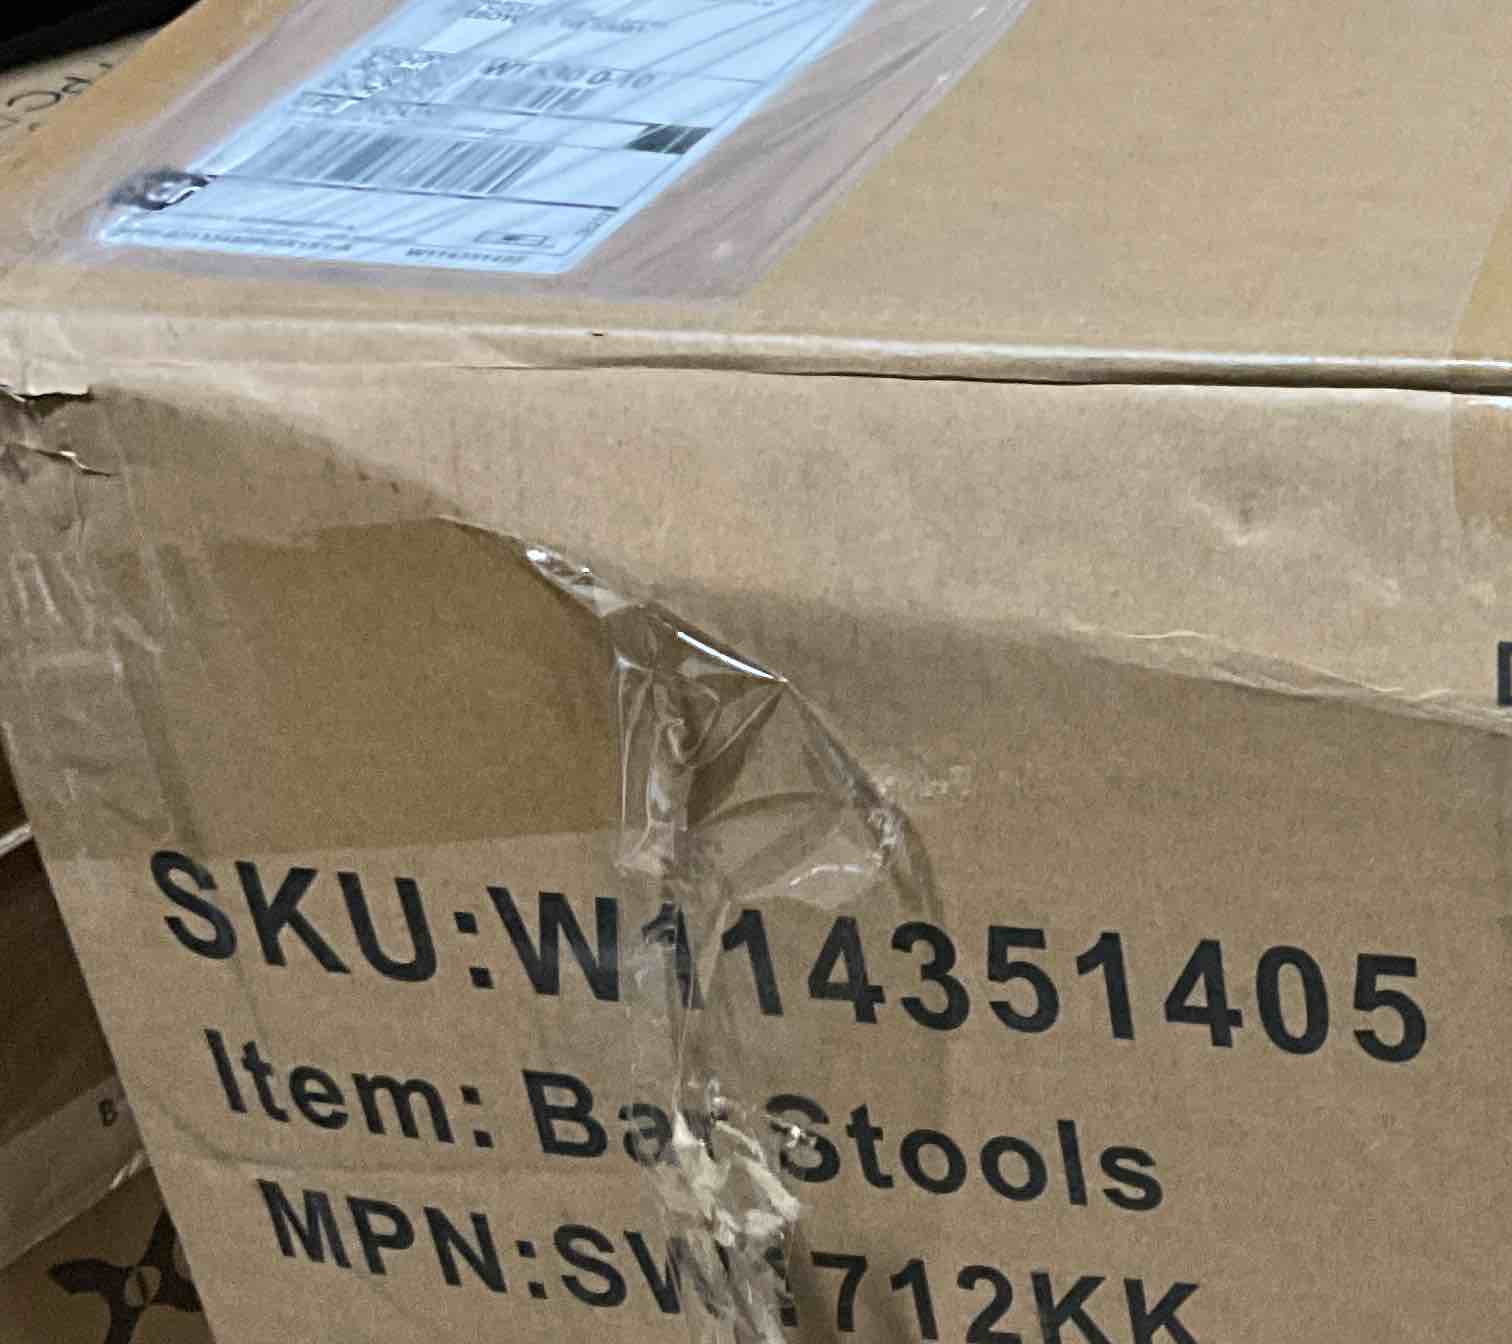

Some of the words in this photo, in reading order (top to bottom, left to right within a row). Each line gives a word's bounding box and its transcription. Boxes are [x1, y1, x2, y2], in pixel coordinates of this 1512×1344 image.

[203, 1028, 495, 1149] Item:
[521, 1069, 715, 1168] Ba
[764, 1093, 1164, 1211] Stools
